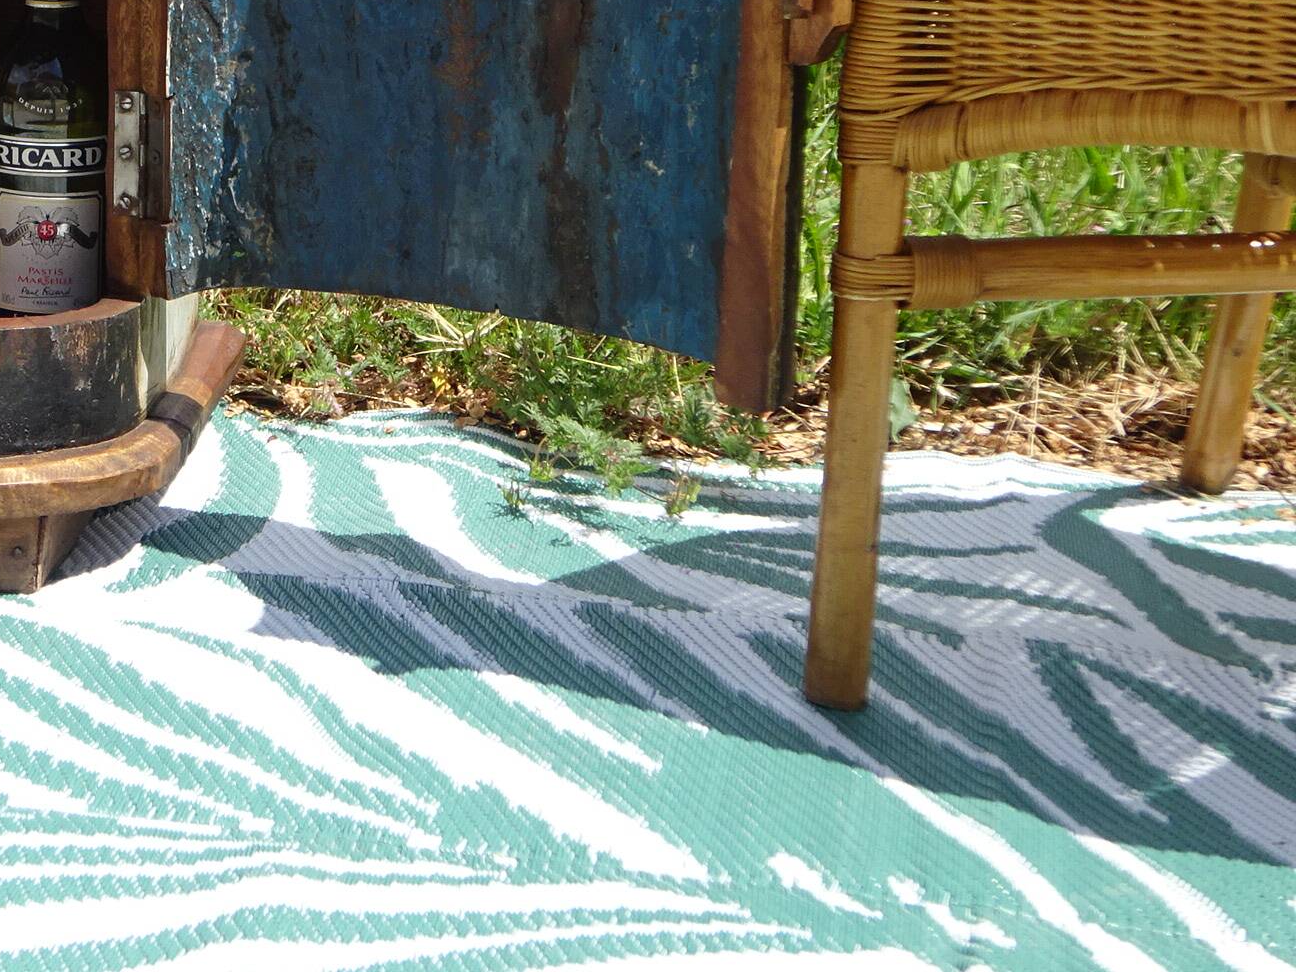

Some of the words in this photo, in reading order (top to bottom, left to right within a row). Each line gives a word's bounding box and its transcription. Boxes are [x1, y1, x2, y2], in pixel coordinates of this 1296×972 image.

[18, 96, 54, 114] DEPUIS
[39, 223, 55, 236] 45
[28, 266, 65, 276] PASTIS
